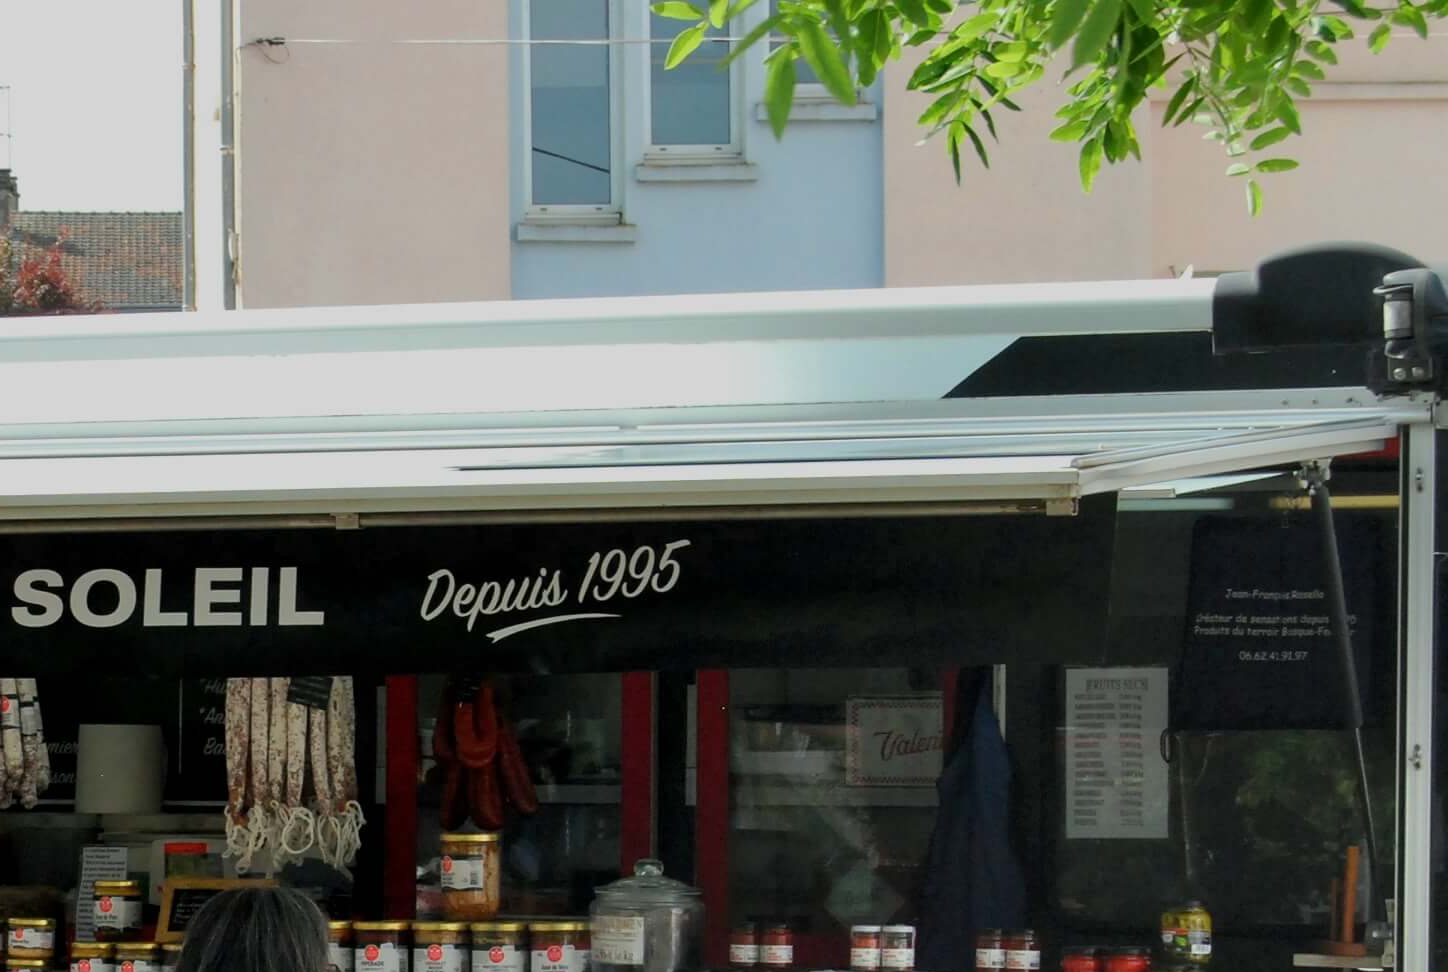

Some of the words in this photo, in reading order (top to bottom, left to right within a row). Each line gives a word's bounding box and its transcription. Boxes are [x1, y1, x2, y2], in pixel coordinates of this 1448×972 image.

[11, 566, 325, 629] SOLEIL
[420, 567, 568, 633] Depuis
[578, 539, 692, 603] 1995
